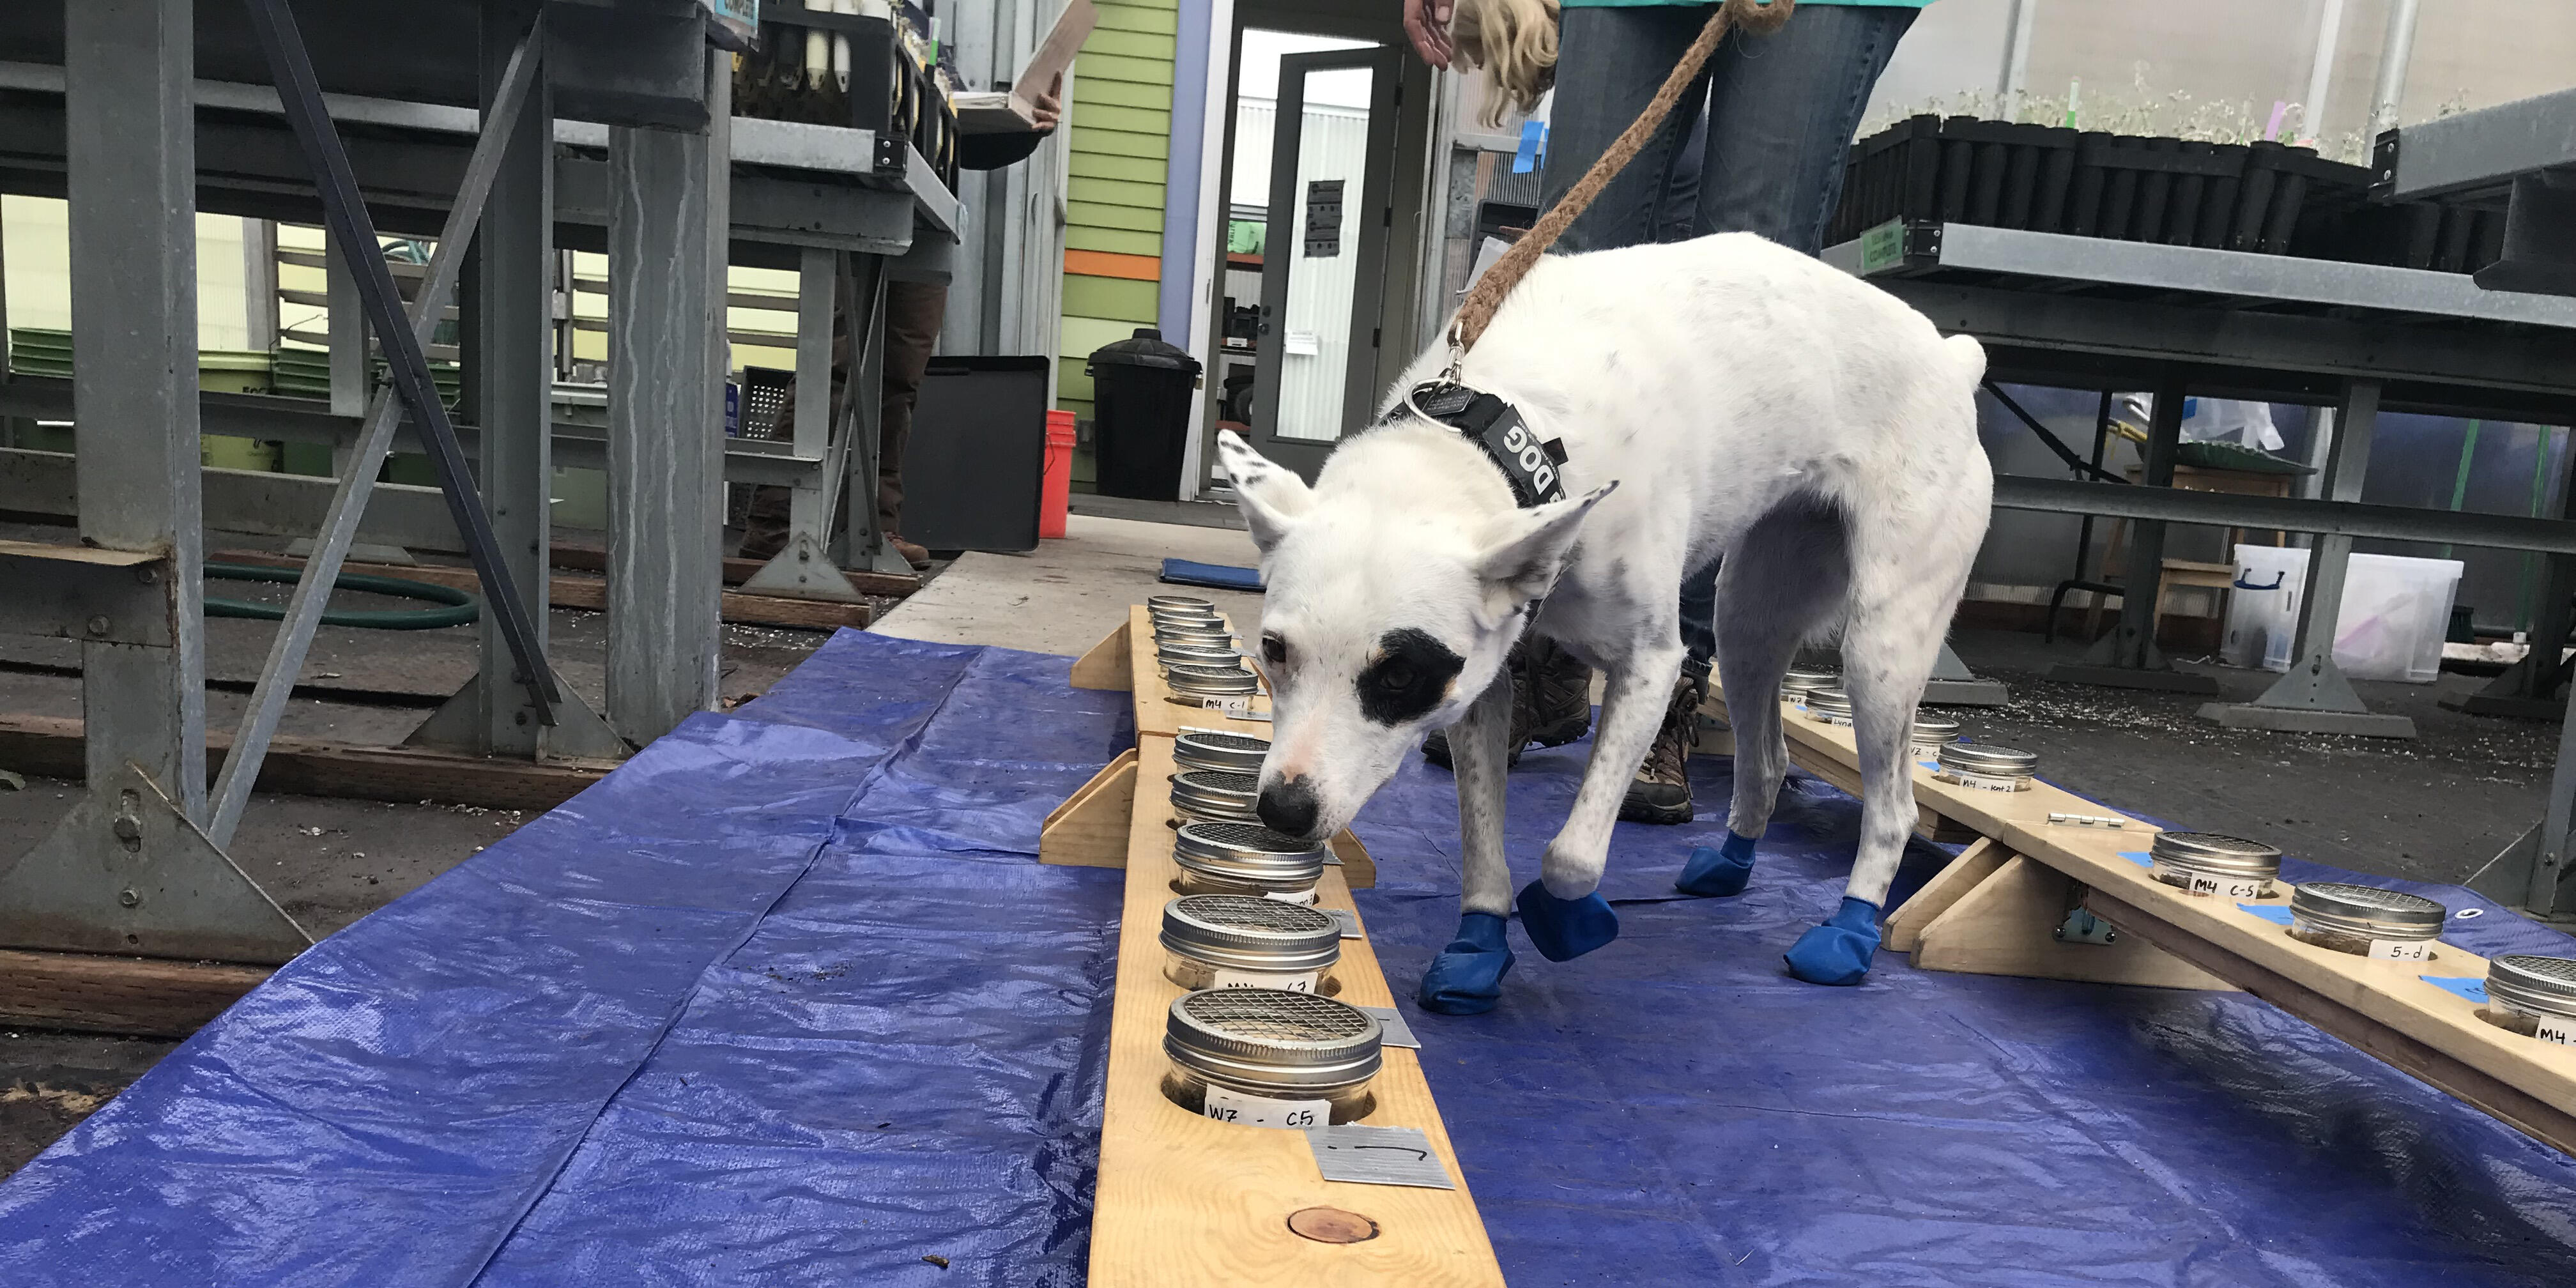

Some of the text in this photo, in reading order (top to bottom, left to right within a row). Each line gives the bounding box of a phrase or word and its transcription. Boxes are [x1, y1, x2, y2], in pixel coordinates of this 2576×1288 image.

[1503, 425, 1554, 495] DOG
[1206, 699, 1222, 709] M4
[2194, 878, 2218, 894] M4
[2540, 1028, 2565, 1045] M4
[1209, 1104, 1238, 1123] W7
[1286, 1110, 1314, 1126] C5
